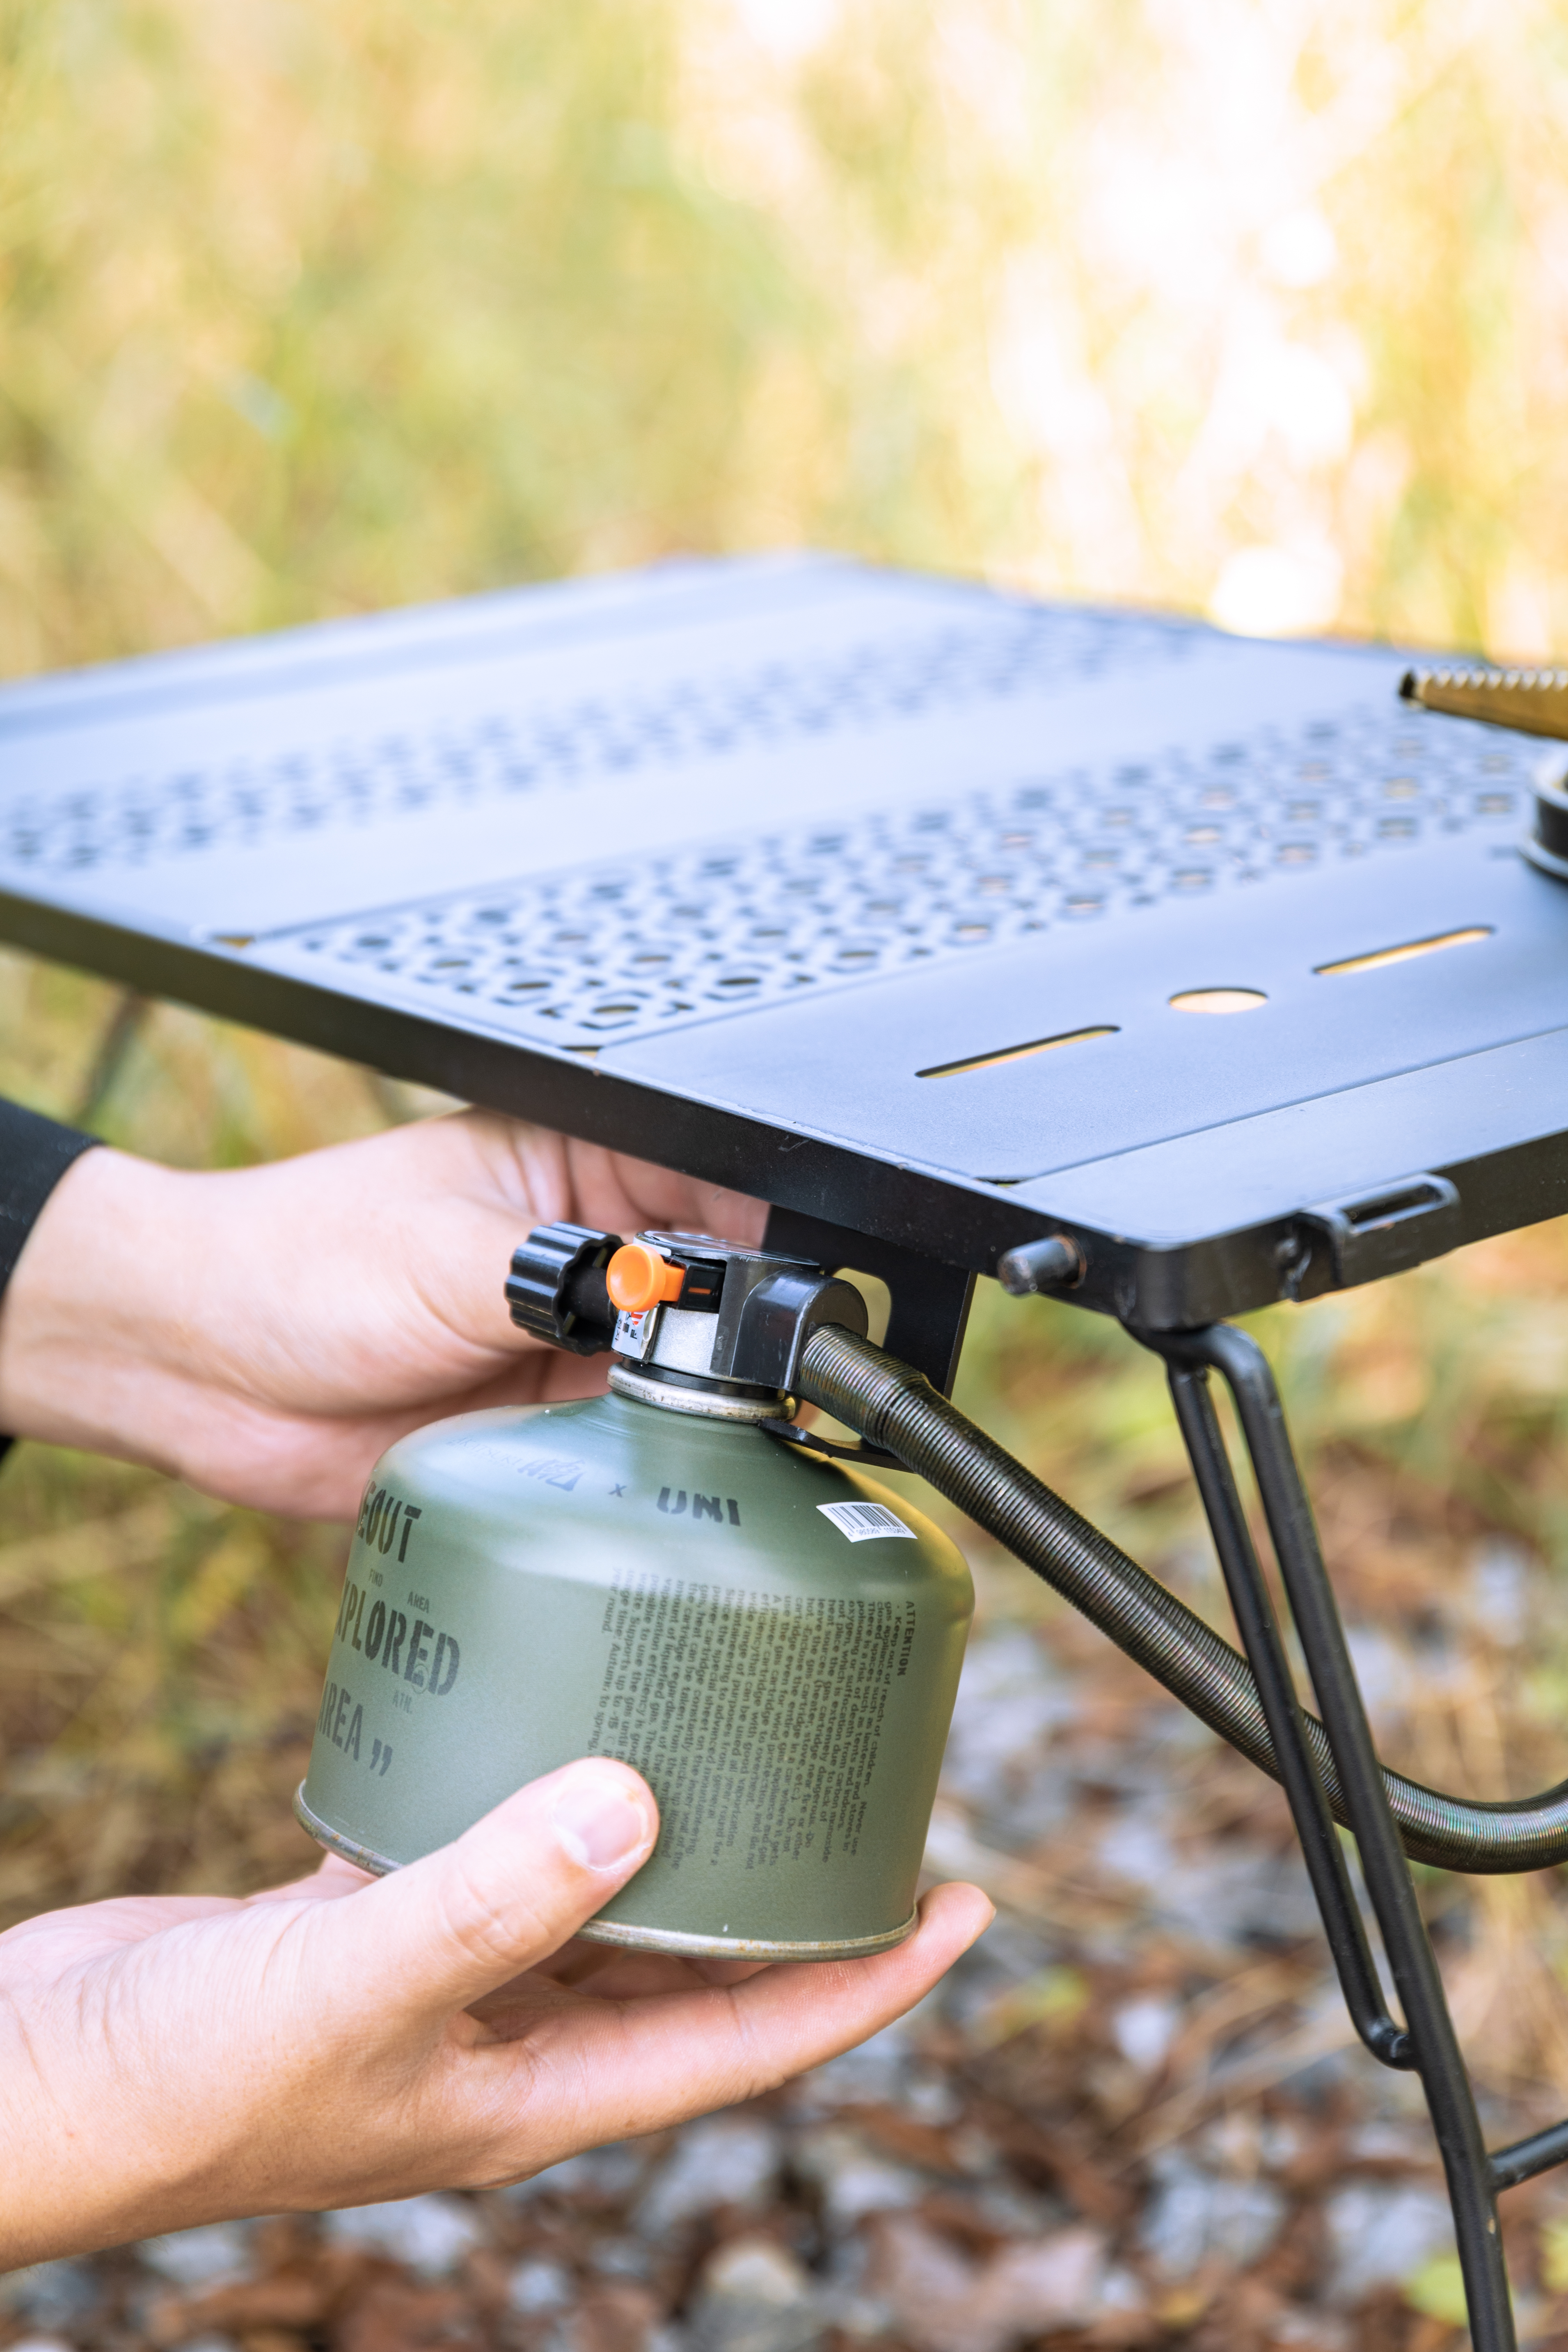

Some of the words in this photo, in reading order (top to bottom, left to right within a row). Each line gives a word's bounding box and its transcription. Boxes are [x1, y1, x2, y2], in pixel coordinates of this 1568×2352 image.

[356, 1480, 422, 1563] EOUT
[657, 1486, 740, 1526] UNI
[368, 1568, 384, 1587] FIND
[688, 1583, 697, 1603] the
[407, 1591, 430, 1614] AREA
[671, 1580, 681, 1624] amount
[696, 1584, 707, 1609] gas,
[709, 1586, 718, 1626] power
[721, 1588, 734, 1622] Since
[747, 1592, 757, 1623] wide
[806, 1598, 815, 1621] hot.
[827, 1599, 836, 1628] heat
[884, 1601, 892, 1621] gas
[602, 1598, 615, 1635] round.
[652, 1577, 667, 1651] vaporization
[694, 1612, 706, 1639] heat
[767, 1608, 778, 1647] power
[788, 1596, 802, 1651] cartridge
[815, 1598, 825, 1632] leave
[843, 1600, 854, 1647] oxygen,
[850, 1600, 865, 1656] poisoning
[866, 1601, 875, 1637] There
[874, 1601, 886, 1640] closed
[621, 1616, 640, 1672] Supports
[675, 1607, 691, 1663] cartridge
[717, 1625, 728, 1646] the
[720, 1589, 742, 1683] mountaineering
[739, 1625, 751, 1659] range
[779, 1621, 790, 1642] the
[810, 1635, 821, 1656] the
[833, 1622, 843, 1653] place
[890, 1616, 902, 1647] Keep
[897, 1601, 915, 1676] ATTENTION
[636, 1644, 645, 1667] use
[689, 1642, 697, 1662] can
[696, 1628, 712, 1686] cartridge
[774, 1644, 783, 1665] gas
[806, 1658, 815, 1679] gas
[817, 1630, 831, 1676] sources
[828, 1656, 838, 1677] the
[837, 1649, 848, 1684] which
[866, 1642, 878, 1682] spaces
[875, 1625, 890, 1683] appliances
[886, 1650, 895, 1670] out
[630, 1671, 641, 1692] the
[636, 1653, 656, 1716] efficiency
[655, 1643, 673, 1699] liquefied
[708, 1648, 721, 1692] special
[753, 1650, 769, 1707] cartridge
[782, 1655, 793, 1686] even
[791, 1675, 802, 1697] the
[856, 1662, 866, 1684] risk
[625, 1696, 634, 1717] gas
[662, 1665, 679, 1733] regardless
[677, 1686, 690, 1721] taken
[724, 1679, 740, 1737] purposes
[743, 1681, 752, 1702] can
[761, 1669, 778, 1726] cartridge
[778, 1689, 788, 1708] for
[806, 1679, 824, 1729] (heater,
[822, 1680, 832, 1702] gas
[836, 1674, 853, 1741] suffocation
[860, 1685, 870, 1713] such
[869, 1686, 879, 1714] such
[876, 1688, 887, 1723] reach
[316, 1680, 363, 1761] AREA
[650, 1702, 659, 1725] gas.
[682, 1689, 700, 1752] constantly
[700, 1695, 713, 1732] sheet
[748, 1711, 758, 1739] with
[770, 1711, 781, 1741] wind
[783, 1701, 795, 1738] entire
[793, 1683, 809, 1739] cartridge
[846, 1703, 859, 1738] death
[588, 1711, 604, 1752] spring,
[618, 1721, 629, 1747] until
[671, 1724, 683, 1753] from
[707, 1704, 723, 1764] advanced
[732, 1725, 743, 1757] used
[810, 1705, 826, 1760] cartridge
[819, 1700, 838, 1762] extremely
[850, 1732, 862, 1763] tents
[625, 1732, 640, 1765] good
[654, 1753, 664, 1774] the
[692, 1754, 703, 1777] the
[739, 1741, 752, 1775] good
[777, 1742, 787, 1763] gas
[797, 1731, 810, 1771] stove,
[830, 1744, 841, 1767] due
[839, 1741, 852, 1769] from
[856, 1731, 872, 1779] lanterns
[863, 1741, 877, 1789] children.
[666, 1757, 676, 1777] the
[805, 1763, 815, 1789] near
[845, 1766, 854, 1786] and
[822, 1786, 832, 1808] lack
[832, 1772, 843, 1809] carbon
[852, 1781, 861, 1800] and
[837, 1788, 851, 1832] indoors.
[845, 1803, 856, 1839] stoves
[855, 1800, 867, 1834] Never
[850, 1837, 858, 1856] use
